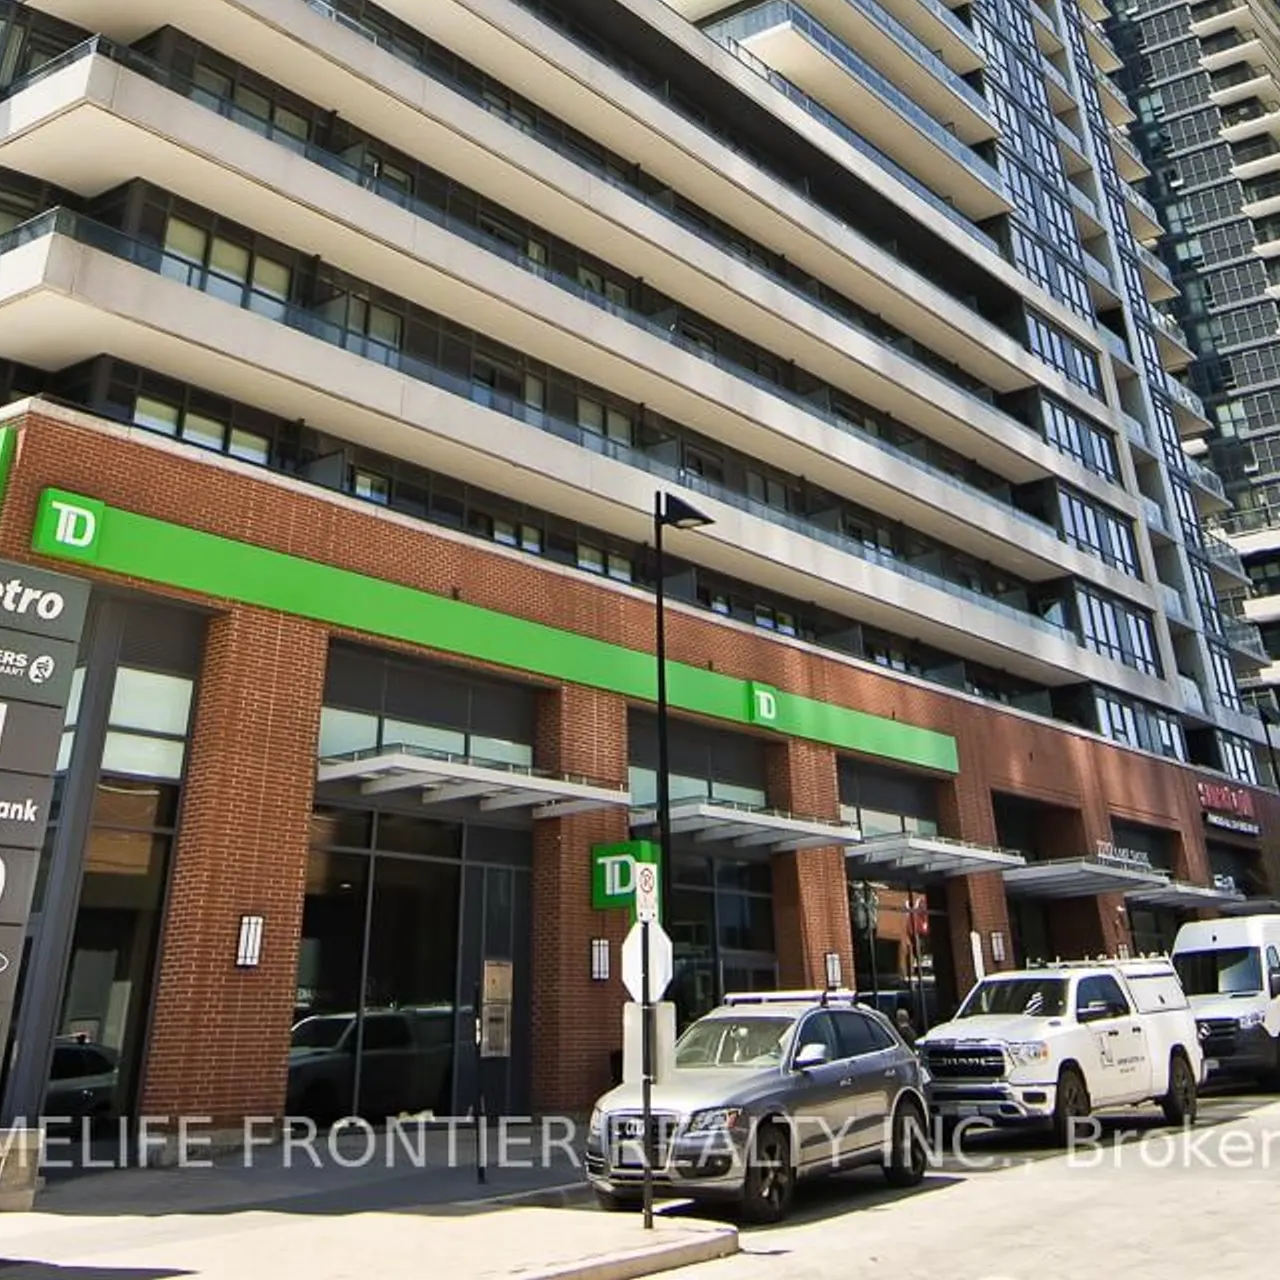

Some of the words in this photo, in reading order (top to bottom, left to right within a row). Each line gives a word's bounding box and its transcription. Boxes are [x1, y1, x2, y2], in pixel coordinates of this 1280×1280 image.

[51, 500, 96, 548] TD
[754, 691, 776, 719] TD
[597, 853, 637, 896] TD
